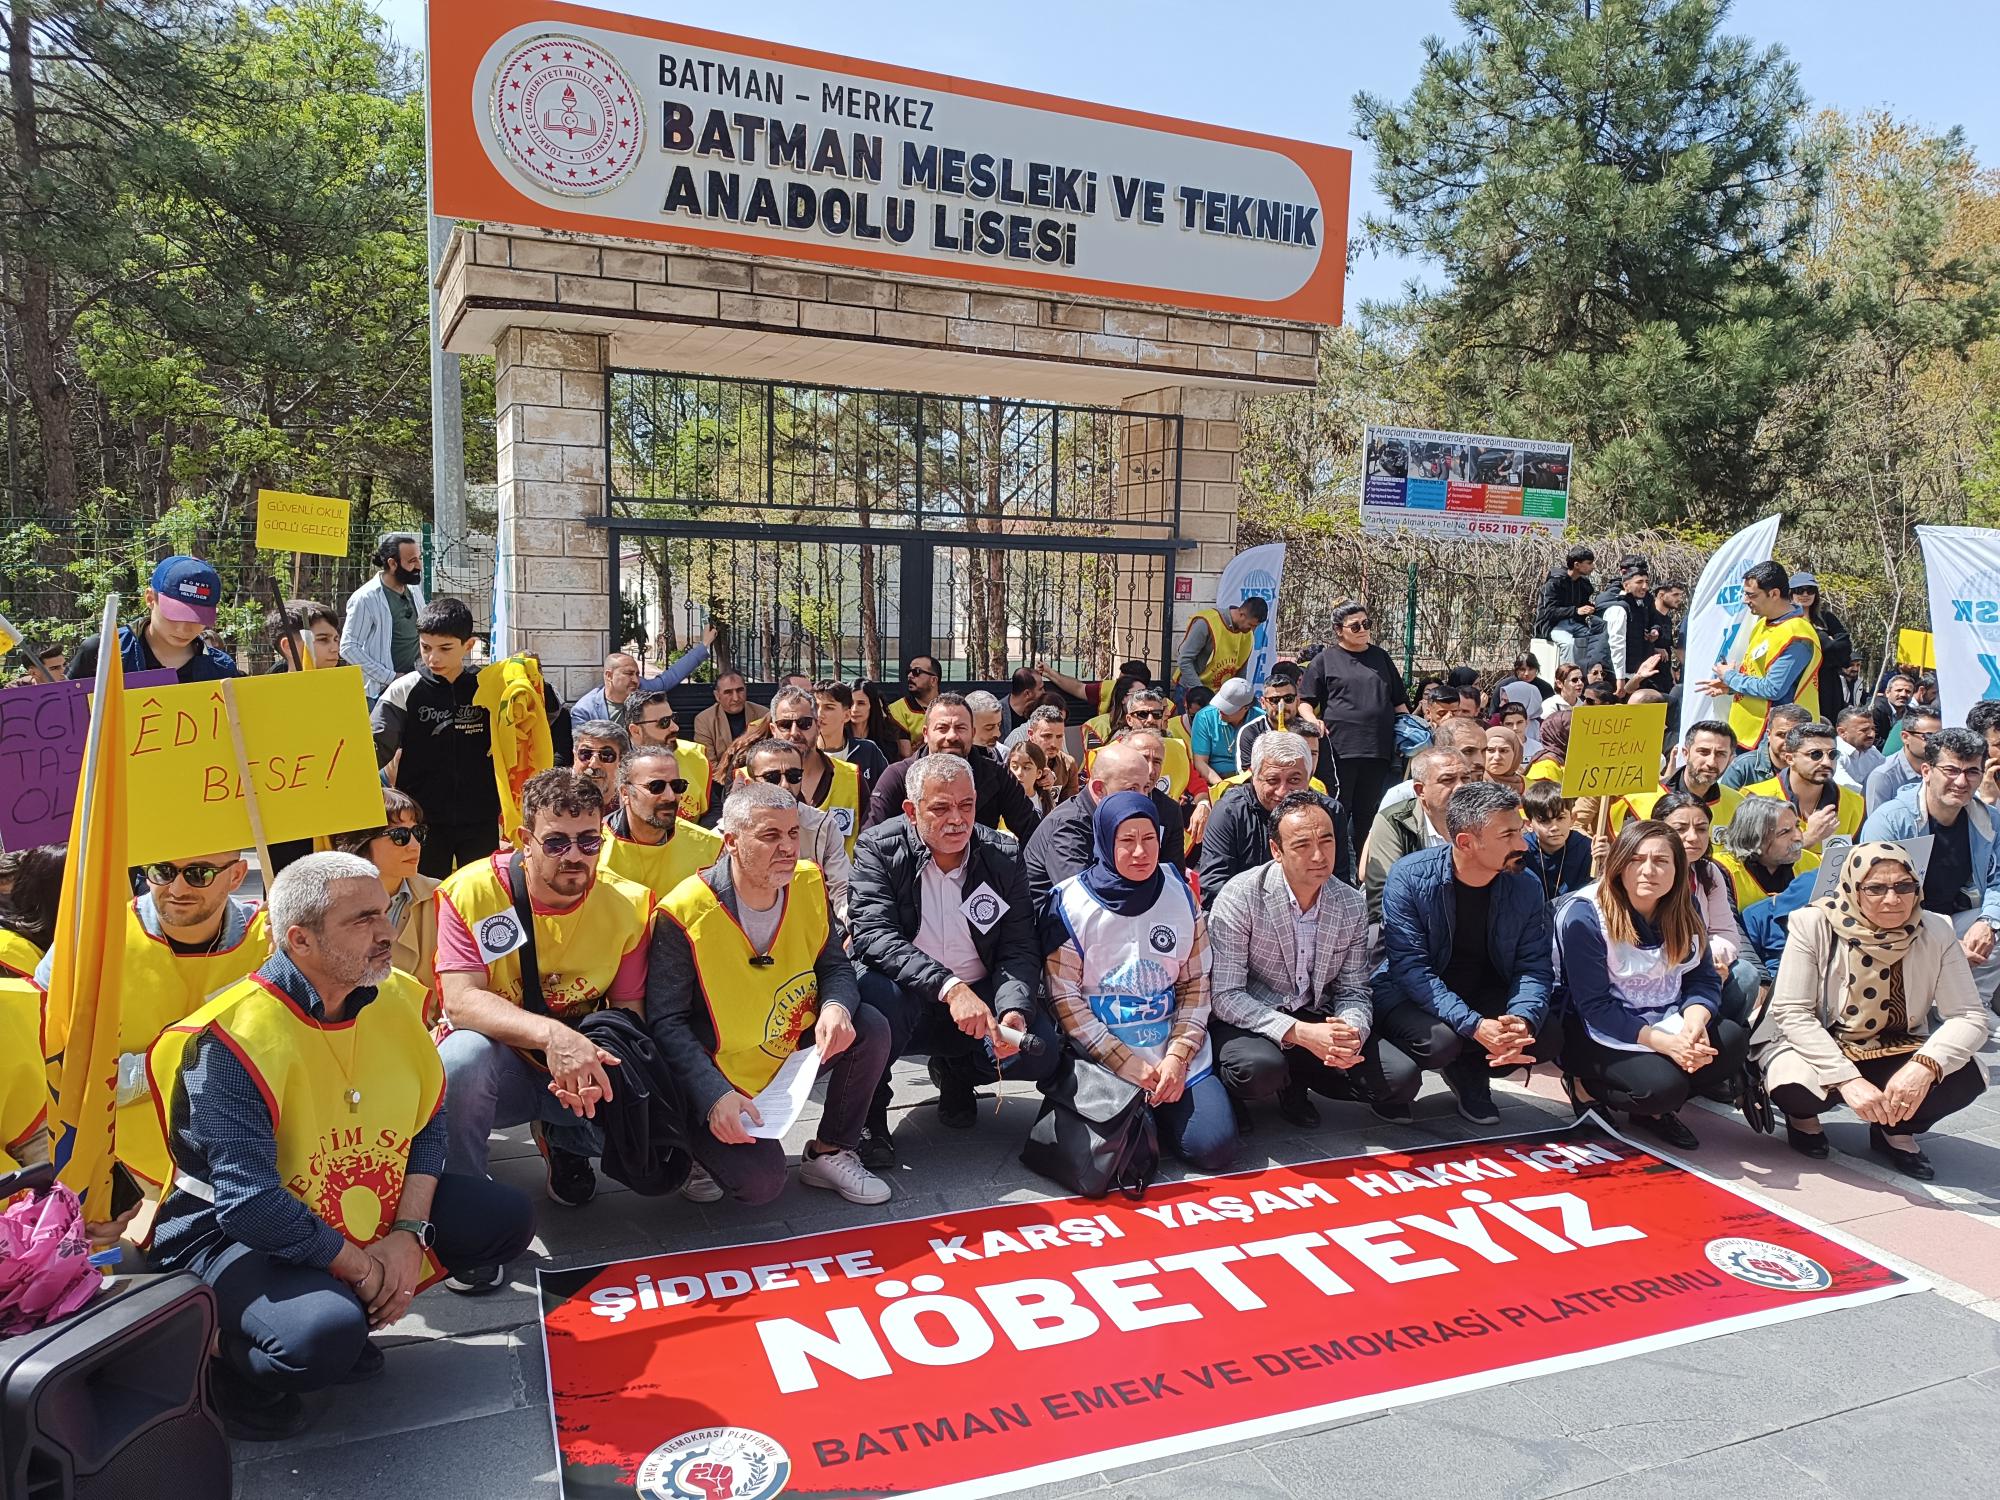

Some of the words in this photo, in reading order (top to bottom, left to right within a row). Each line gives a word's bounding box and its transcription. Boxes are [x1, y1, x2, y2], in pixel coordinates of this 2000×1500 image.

[659, 53, 784, 105] BATMAN
[822, 81, 934, 132] MERKEZ
[660, 100, 884, 183] BATMAN
[1108, 174, 1166, 225] VE
[662, 164, 916, 246] ANADOLU
[264, 519, 299, 532] GÜÇLÜ
[301, 524, 347, 538] GELECEK
[267, 501, 314, 515] GÜVENLİ
[317, 507, 345, 519] OKUL
[1478, 522, 1500, 533] 552
[1502, 524, 1518, 533] 118
[1581, 717, 1633, 735] YUSUF
[590, 1249, 885, 1323] ŞİDDETE
[927, 1212, 1126, 1265] KARŞI
[1141, 1181, 1340, 1230] YAŞAM
[1346, 1156, 1518, 1200] HAKKI
[1511, 1141, 1625, 1177] İÇİN
[754, 1189, 1649, 1395] NÖBETTEYİZ
[811, 1401, 1030, 1468] BATMAN
[1040, 1371, 1185, 1422] EMEK
[1181, 1359, 1257, 1390] VE
[1260, 1301, 1504, 1377] DEMOKRASİ
[1508, 1267, 1722, 1330] PLATFORMU
[663, 1429, 724, 1454] DEMOKRASİ
[727, 1430, 778, 1457] PLATFORMU
